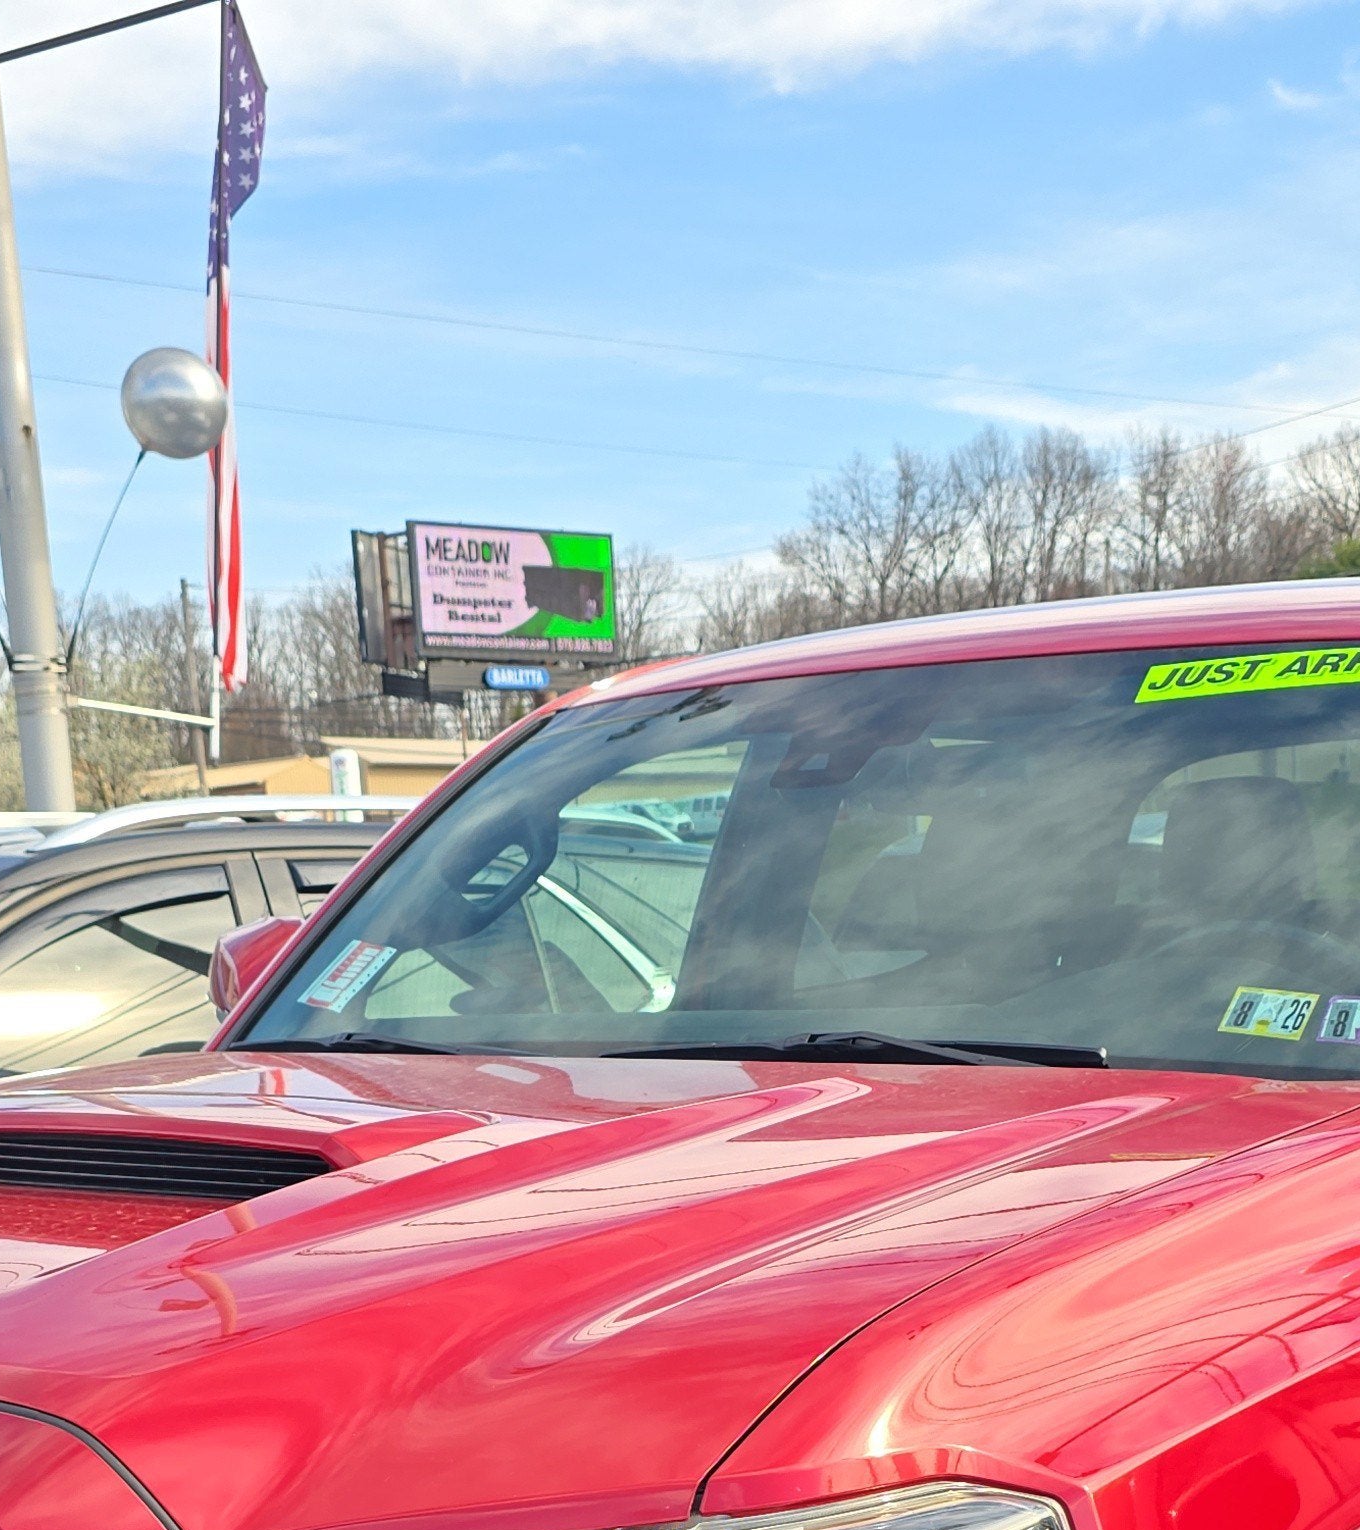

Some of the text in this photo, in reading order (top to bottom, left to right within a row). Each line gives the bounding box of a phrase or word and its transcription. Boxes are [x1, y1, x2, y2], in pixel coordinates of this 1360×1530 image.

[425, 536, 510, 565] MEADOW
[433, 593, 512, 610] Dumpster
[448, 610, 502, 623] Rental
[493, 668, 544, 685] BARLETTA
[1148, 658, 1274, 691] JUST
[1233, 999, 1312, 1031] 8 26
[1332, 1009, 1350, 1037] 8
